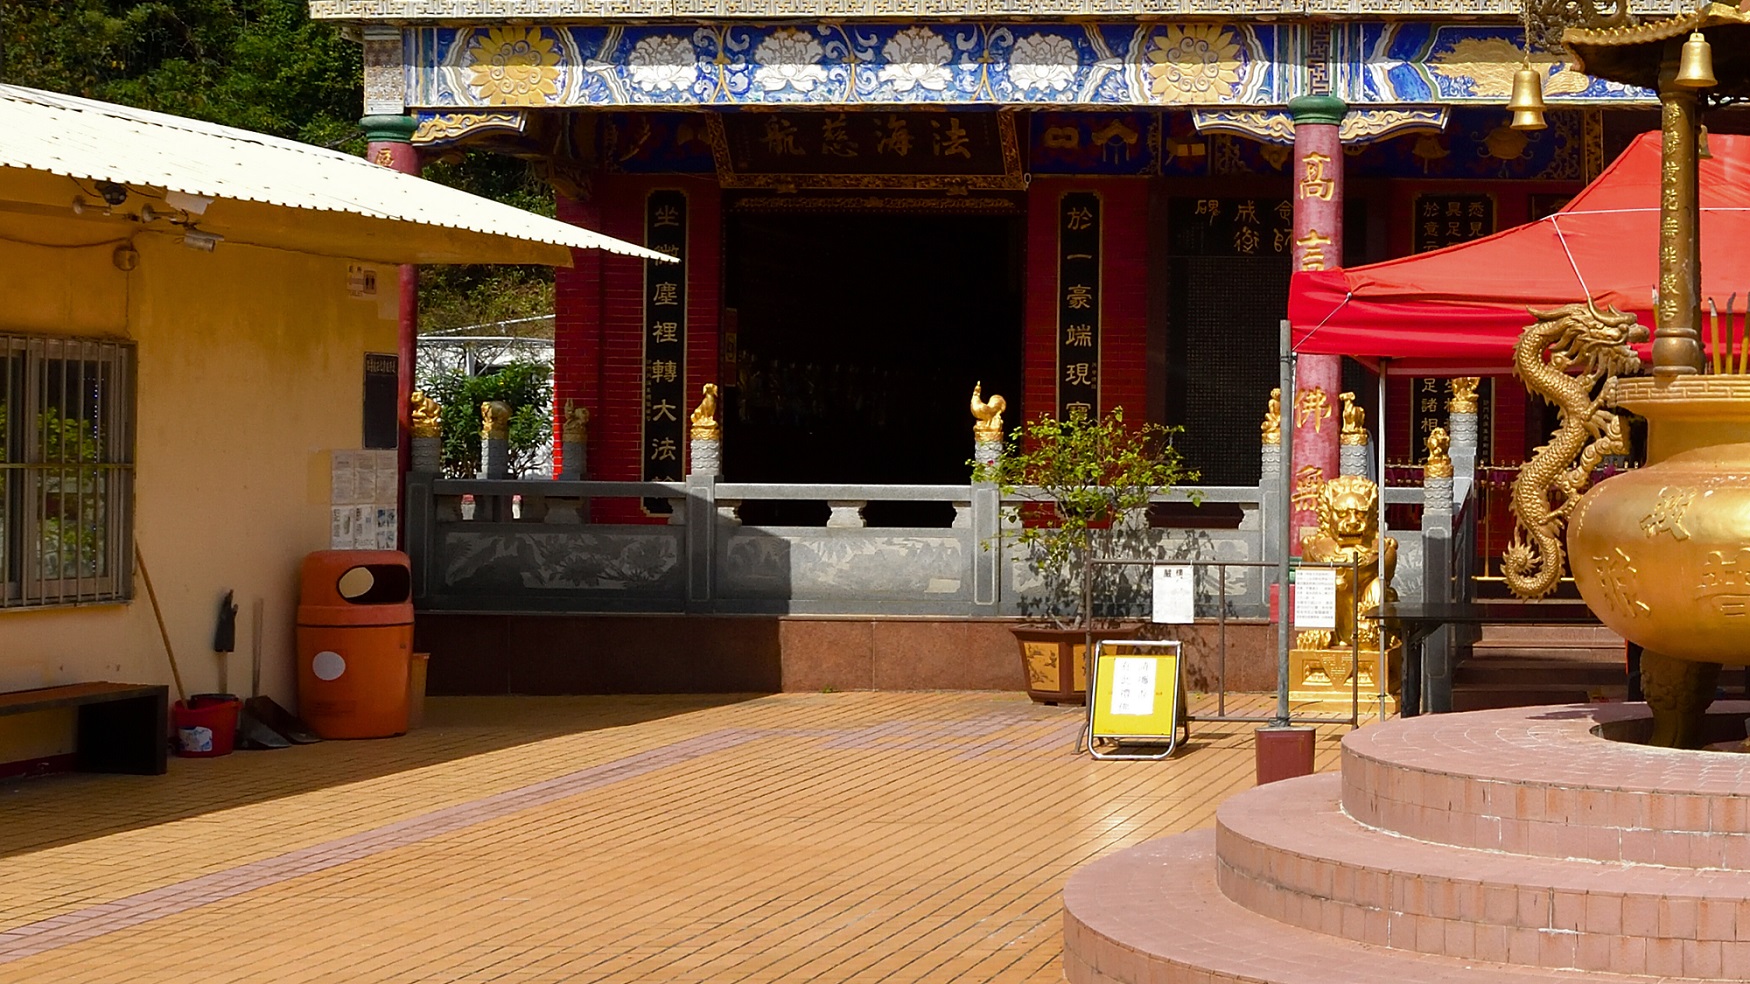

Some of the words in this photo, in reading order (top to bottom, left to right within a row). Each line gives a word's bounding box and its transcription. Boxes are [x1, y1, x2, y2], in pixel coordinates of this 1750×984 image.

[763, 113, 972, 159] 法海慈航
[651, 204, 680, 482] 坐微塵裡轉大法
